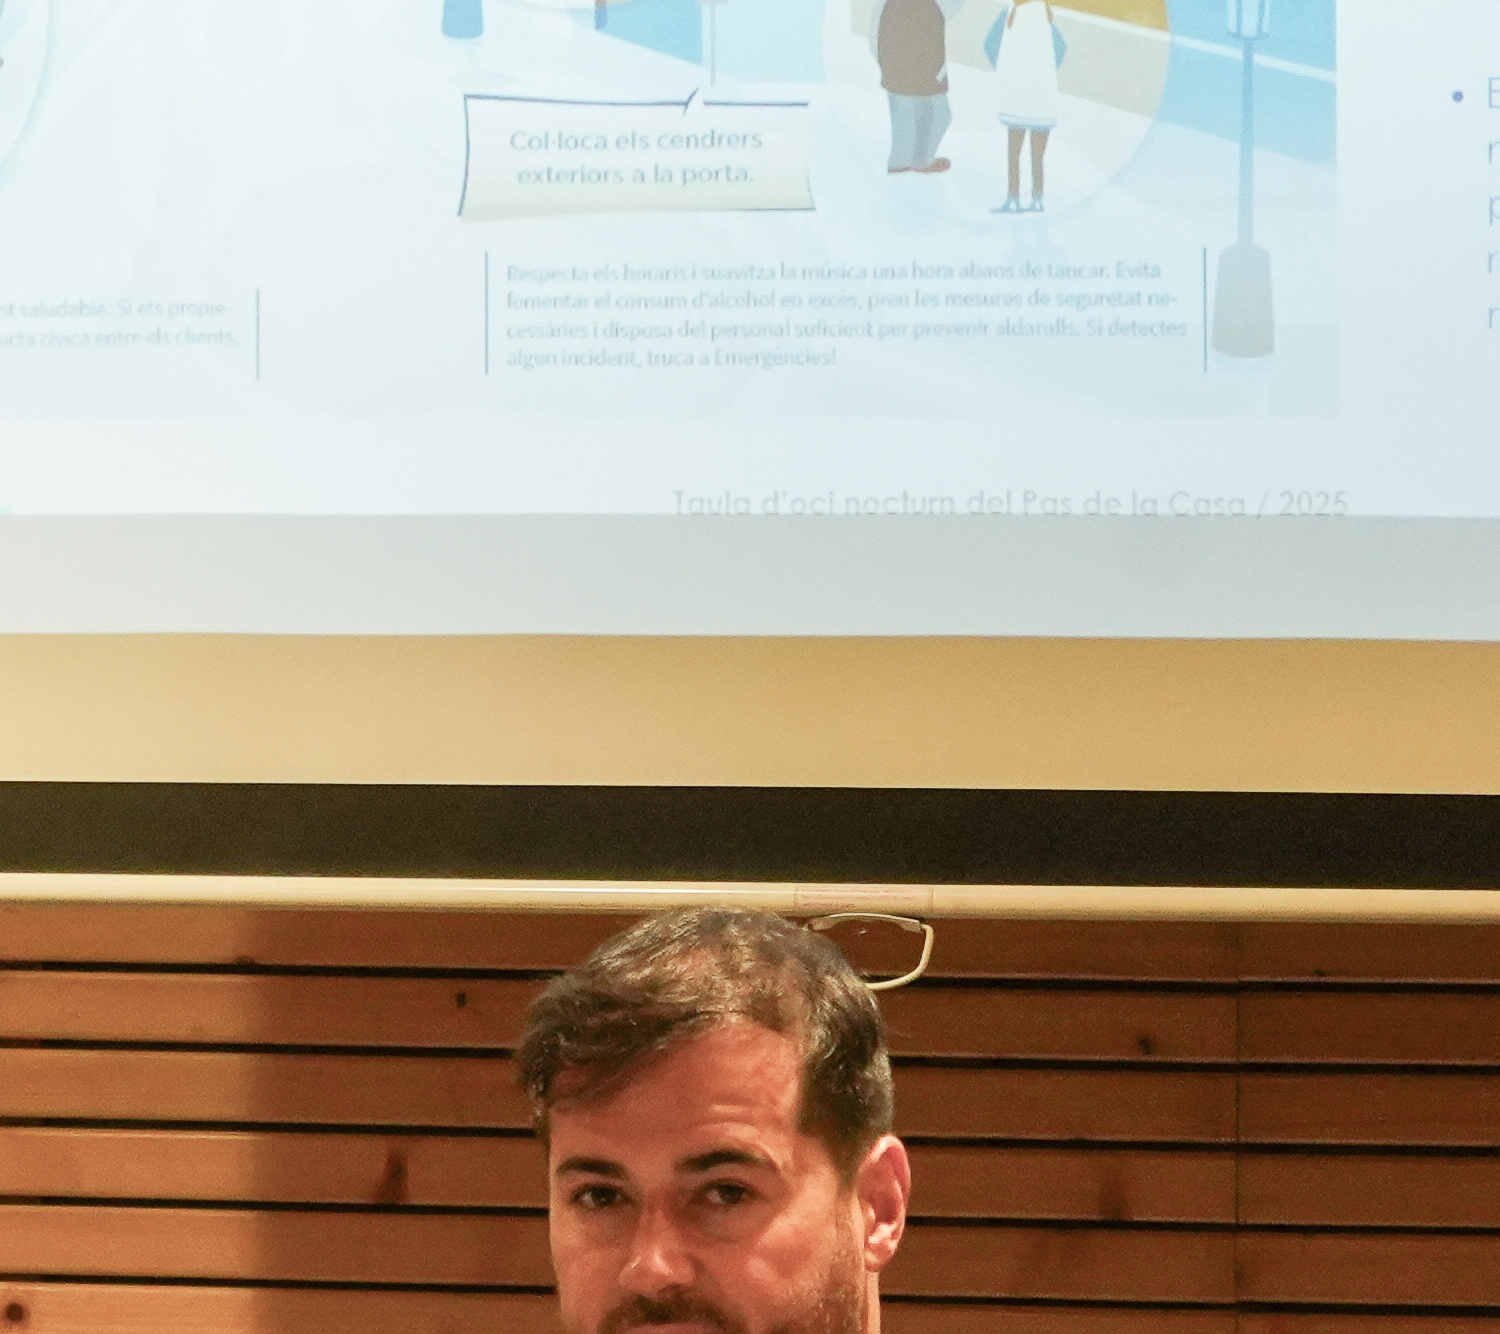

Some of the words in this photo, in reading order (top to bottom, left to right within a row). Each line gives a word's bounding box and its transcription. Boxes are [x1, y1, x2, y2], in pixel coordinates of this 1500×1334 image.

[507, 129, 609, 154] Col·loca
[614, 129, 653, 153] els
[656, 128, 764, 151] cendrers
[517, 166, 627, 188] exteriors
[631, 168, 649, 187] a
[653, 163, 677, 186] la
[681, 165, 757, 190] porta.
[673, 489, 754, 515] Taula
[843, 490, 961, 515] nocturn
[965, 489, 1016, 515] del
[1021, 489, 1075, 515] Pas
[1083, 490, 1124, 515] de
[1131, 491, 1162, 515] la
[1168, 490, 1249, 515] Casa
[1278, 489, 1350, 515] 2025
